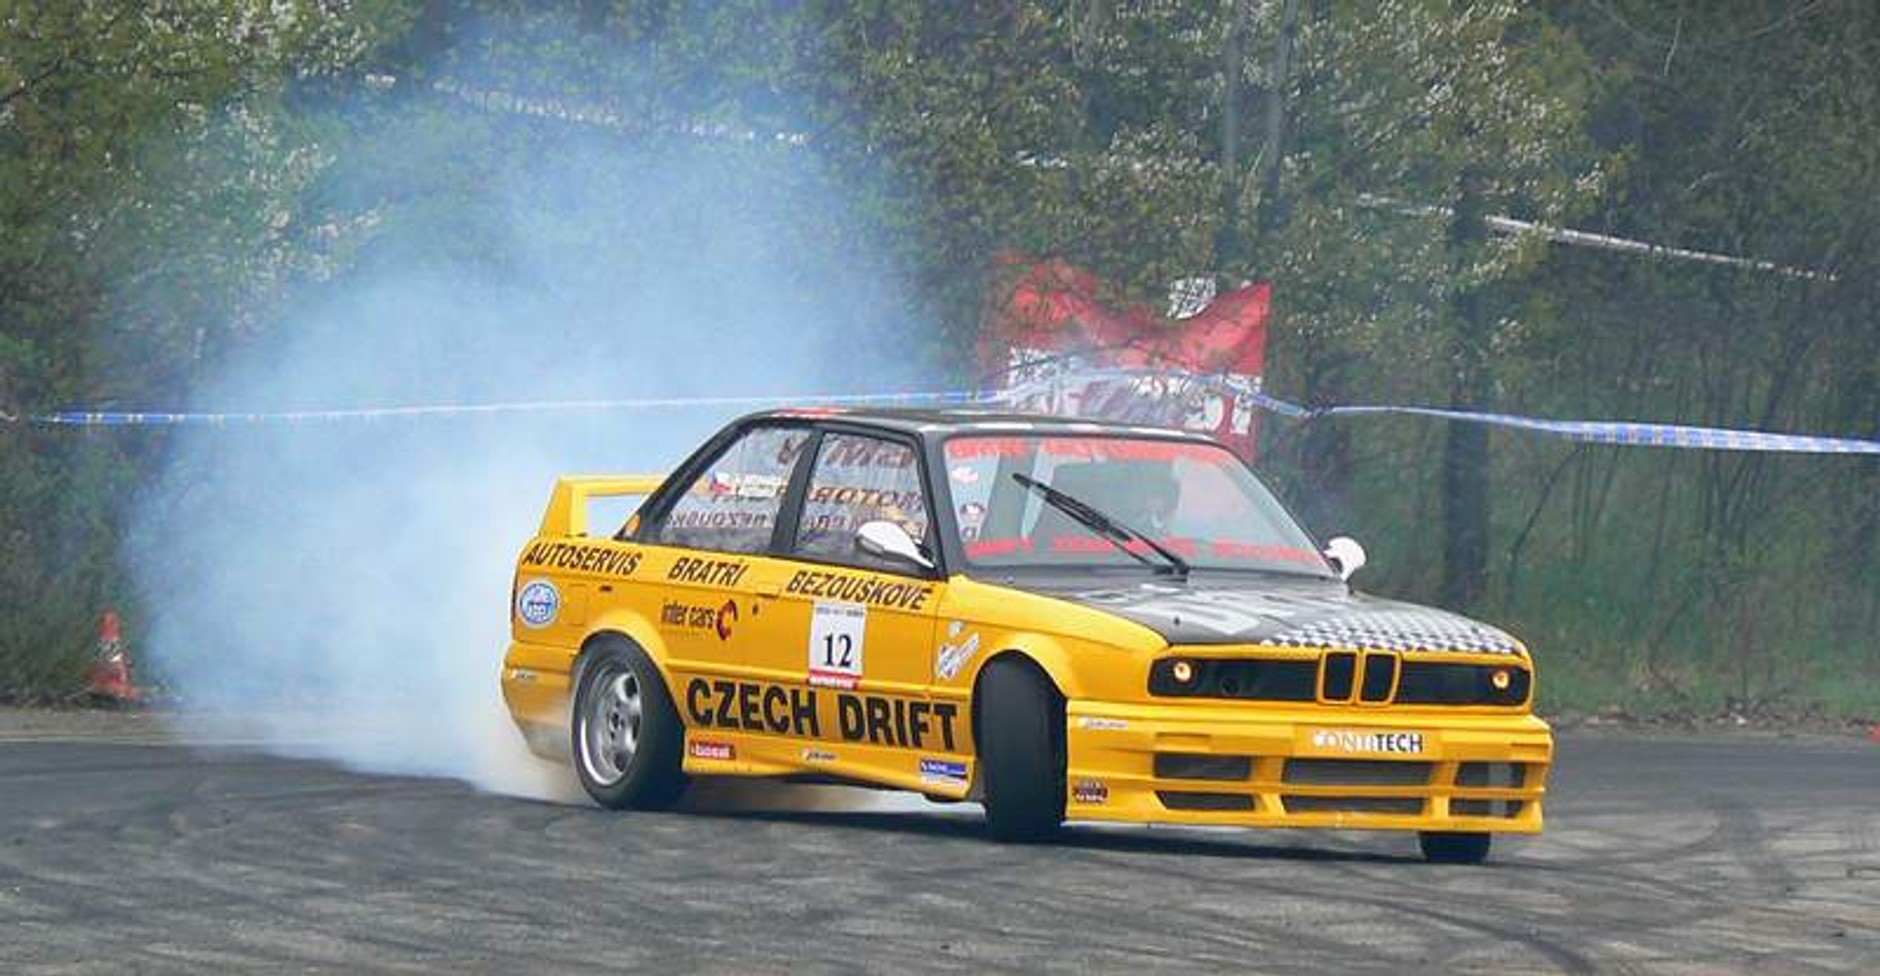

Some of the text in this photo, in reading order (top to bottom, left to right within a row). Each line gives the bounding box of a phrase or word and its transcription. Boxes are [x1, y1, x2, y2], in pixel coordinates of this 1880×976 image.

[521, 542, 643, 576] AUTOSERVIS
[822, 632, 852, 667] 12
[686, 677, 958, 752] CZECH DRIFT
